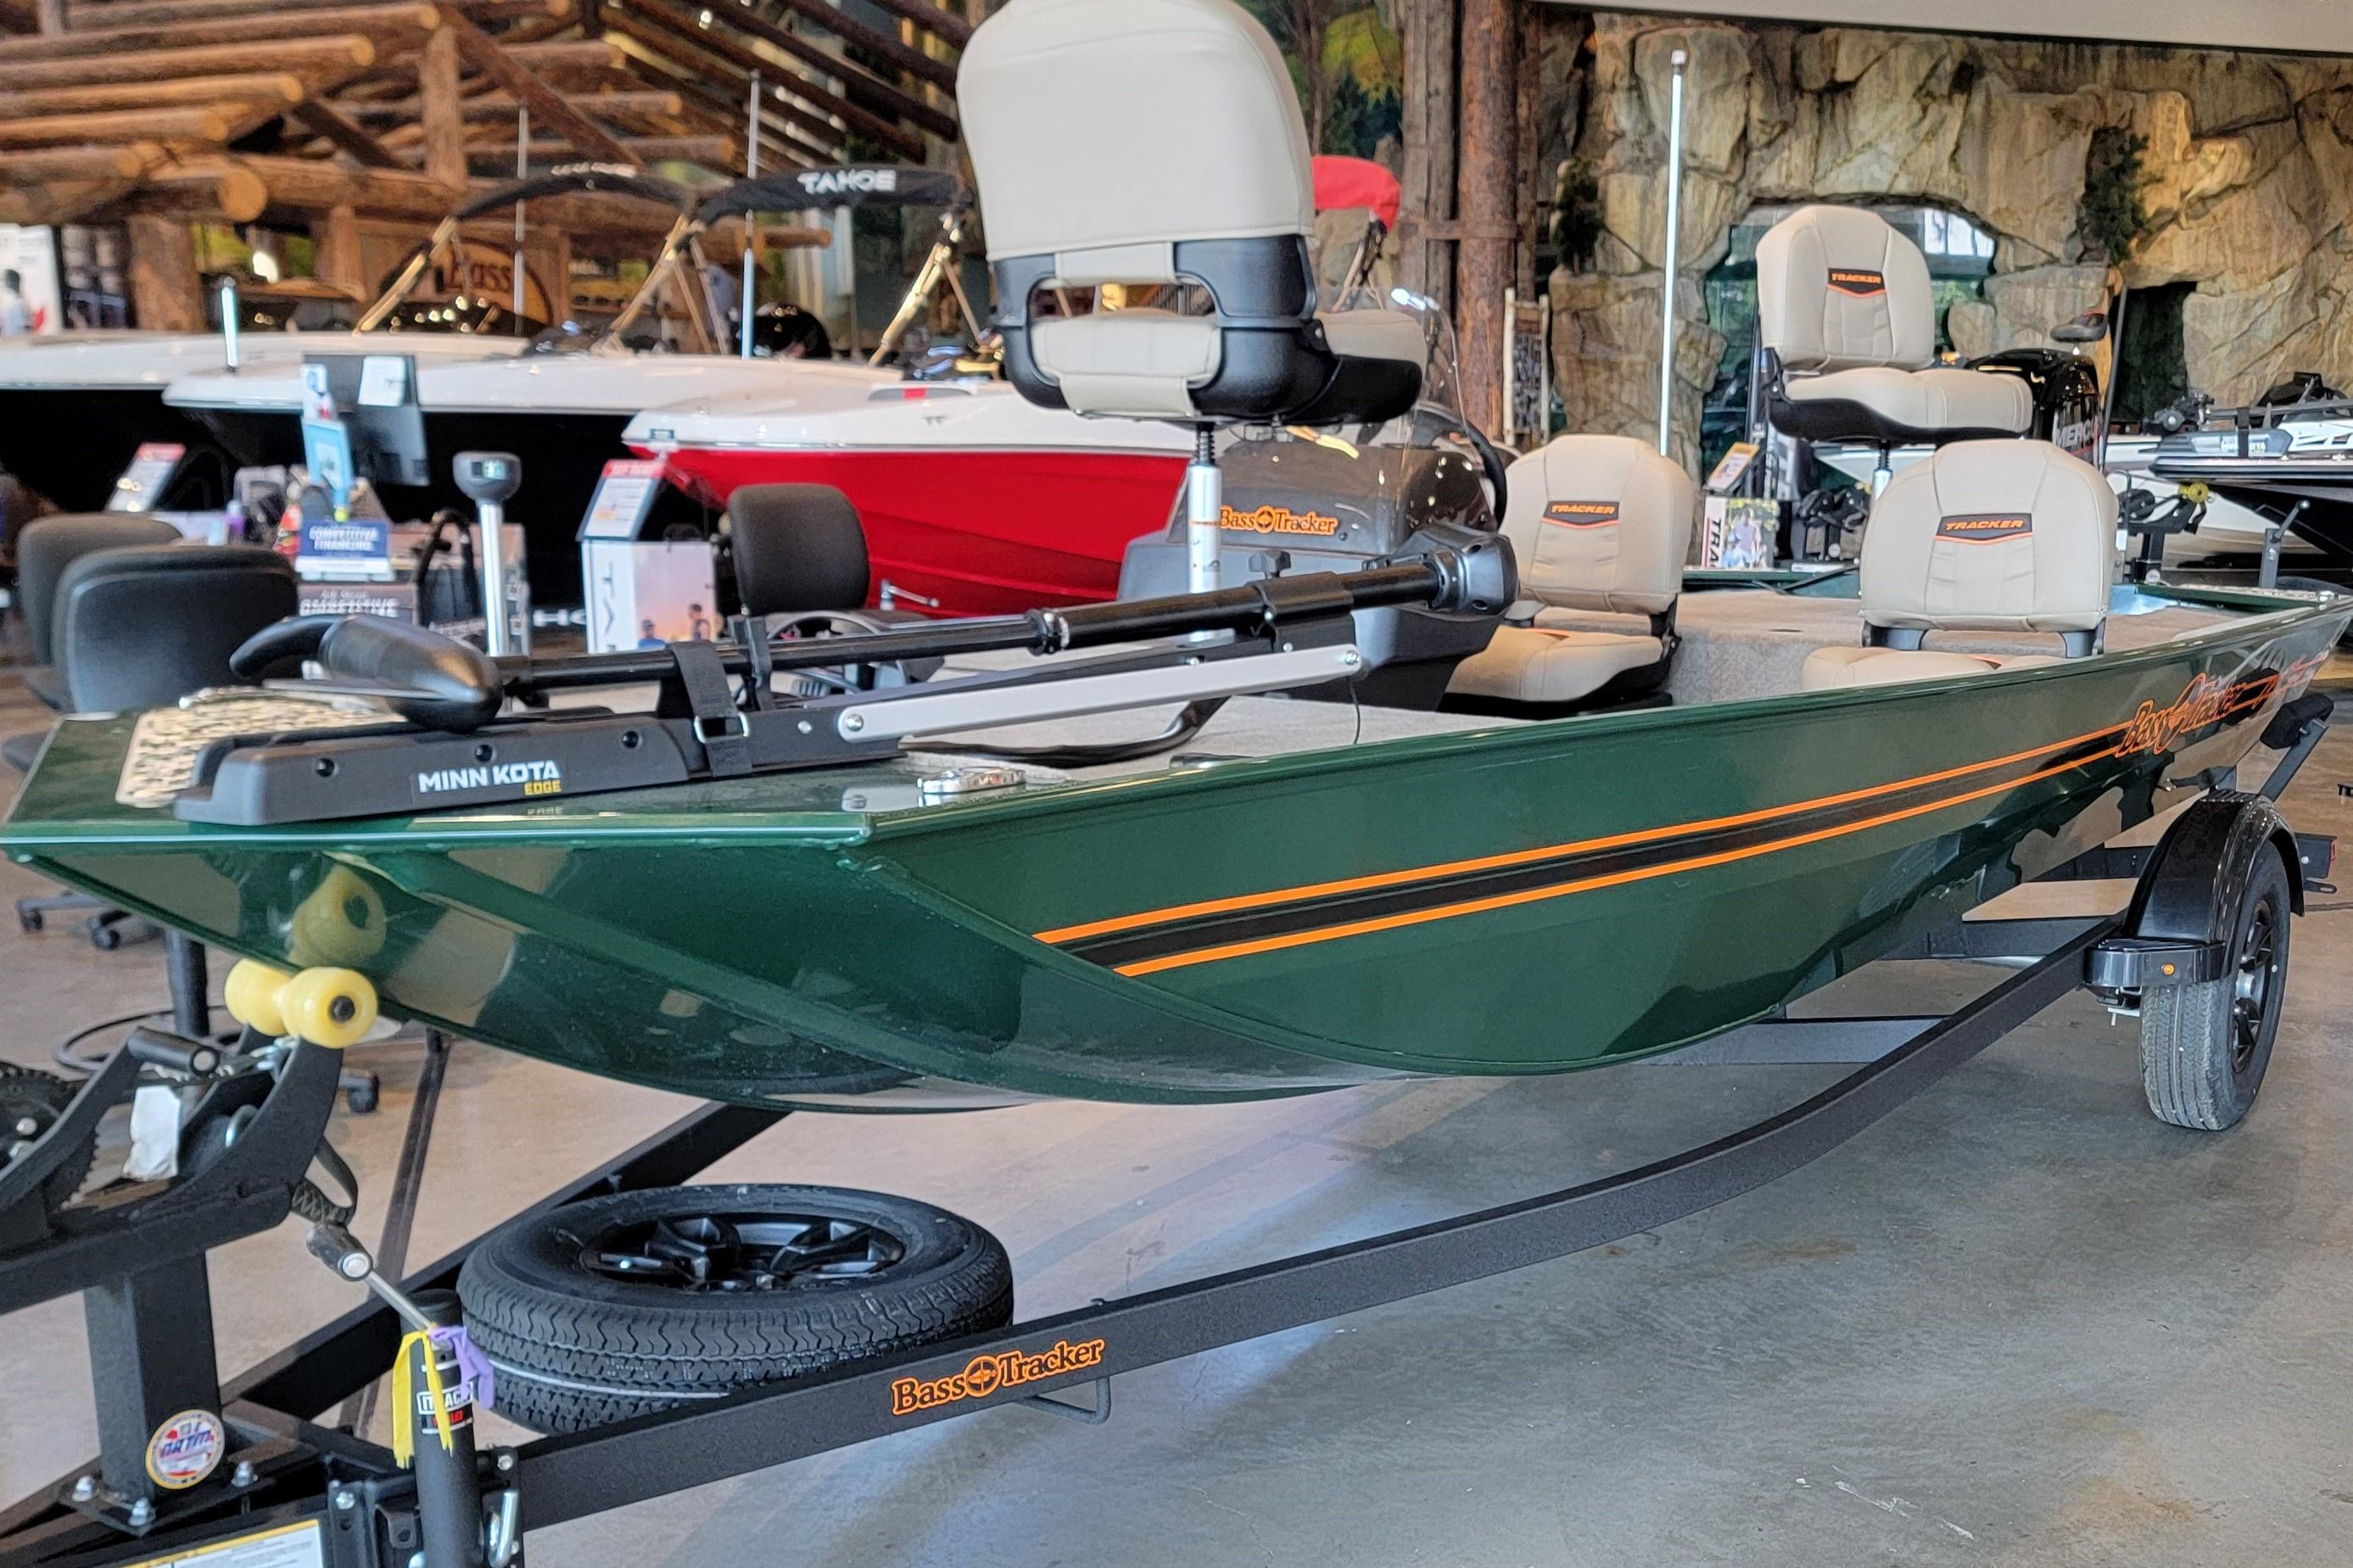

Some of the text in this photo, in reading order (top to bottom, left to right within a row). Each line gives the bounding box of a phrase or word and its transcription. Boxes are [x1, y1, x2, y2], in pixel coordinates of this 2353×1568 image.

[797, 169, 896, 194] TAHOE
[1832, 273, 1881, 284] TRACKER
[1221, 508, 1335, 533] Bass Tracker
[1551, 505, 1616, 515] TRACKER
[1946, 520, 2024, 531] TRACKER
[1709, 519, 1722, 568] TRA
[418, 760, 560, 793] MINN KOTA
[524, 780, 562, 795] EDGE
[894, 1340, 1103, 1412] Bass Tracker
